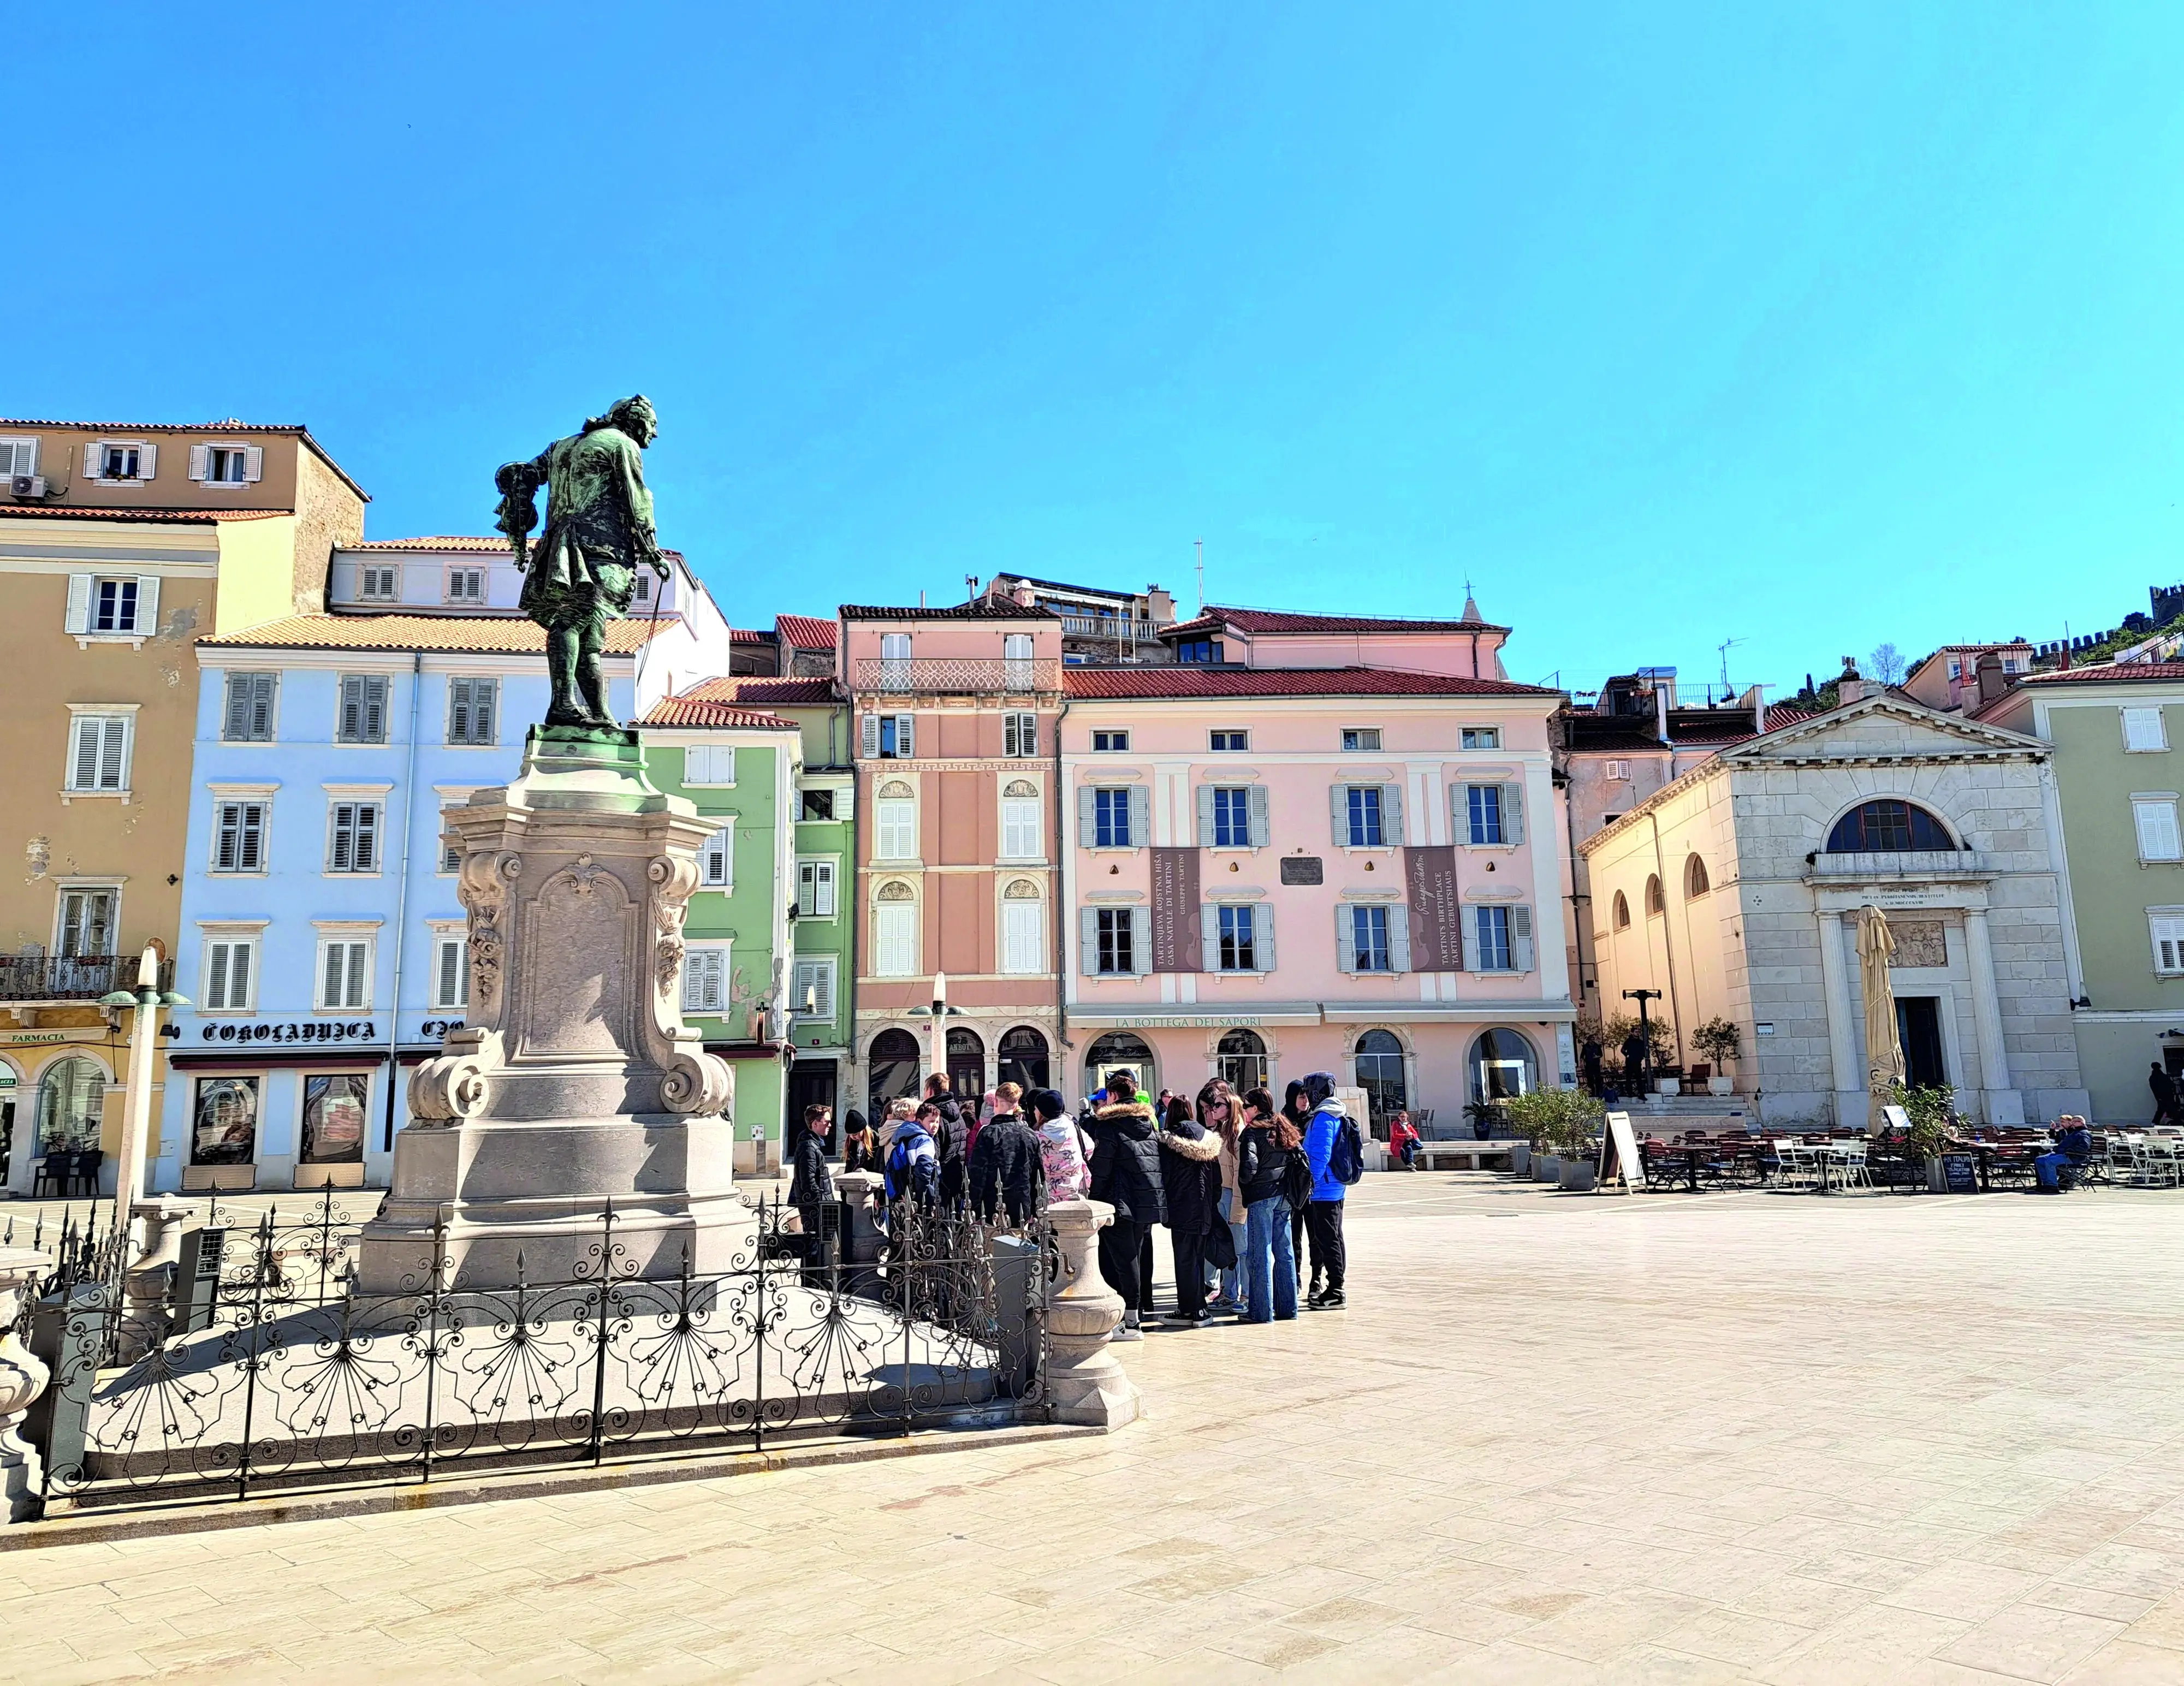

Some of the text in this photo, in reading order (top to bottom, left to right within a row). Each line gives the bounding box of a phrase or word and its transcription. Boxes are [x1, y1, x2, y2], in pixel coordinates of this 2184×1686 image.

[1154, 853, 1162, 872] HIŠA
[1166, 898, 1172, 906] DI
[1435, 871, 1448, 965] TARTINI'S BIRTHPLACE
[1445, 870, 1459, 965] TARTINI GEBURTSHAUS
[1156, 915, 1164, 966] TARTINIJEVA
[203, 1022, 377, 1043] ČOKOLADNICA
[1115, 1017, 1261, 1028] LA BOTTEGA DEI SAPORI
